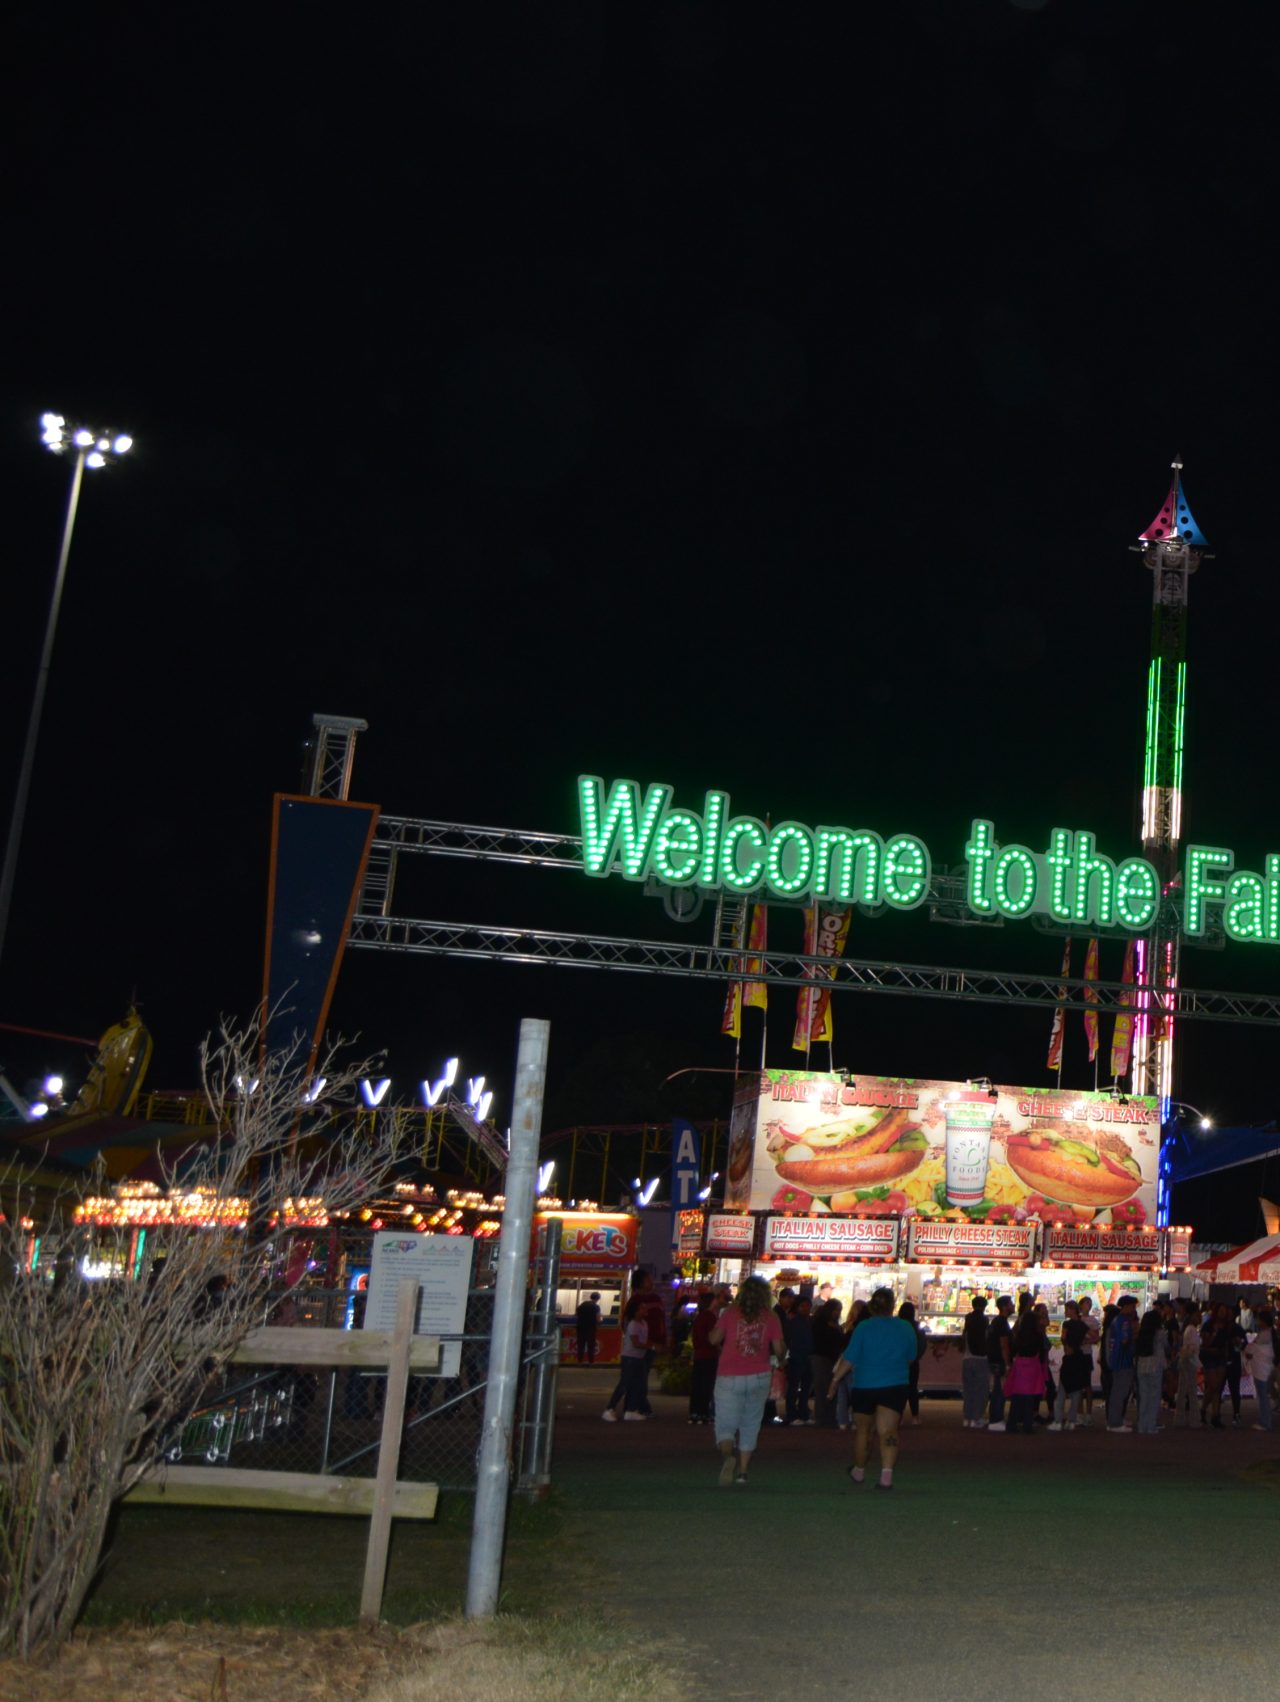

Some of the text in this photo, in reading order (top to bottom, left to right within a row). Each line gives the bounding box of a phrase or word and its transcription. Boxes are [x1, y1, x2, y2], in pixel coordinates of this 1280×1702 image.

[578, 774, 932, 910] Welcome
[965, 818, 1037, 919] to
[1045, 828, 1160, 931] the
[772, 1084, 919, 1109] ITALN SAUSAGE
[1090, 1106, 1149, 1125] STEAK
[711, 1219, 752, 1230] CHEESE
[713, 1229, 749, 1239] STEAK
[770, 1220, 894, 1241] ITALIAN SAUSAGE
[538, 1224, 628, 1257] CKETS
[914, 1225, 1031, 1247] PHILLY CHEESE STEAK
[1049, 1231, 1099, 1249] ITALIAN
[1100, 1233, 1159, 1251] SAUSAGE
